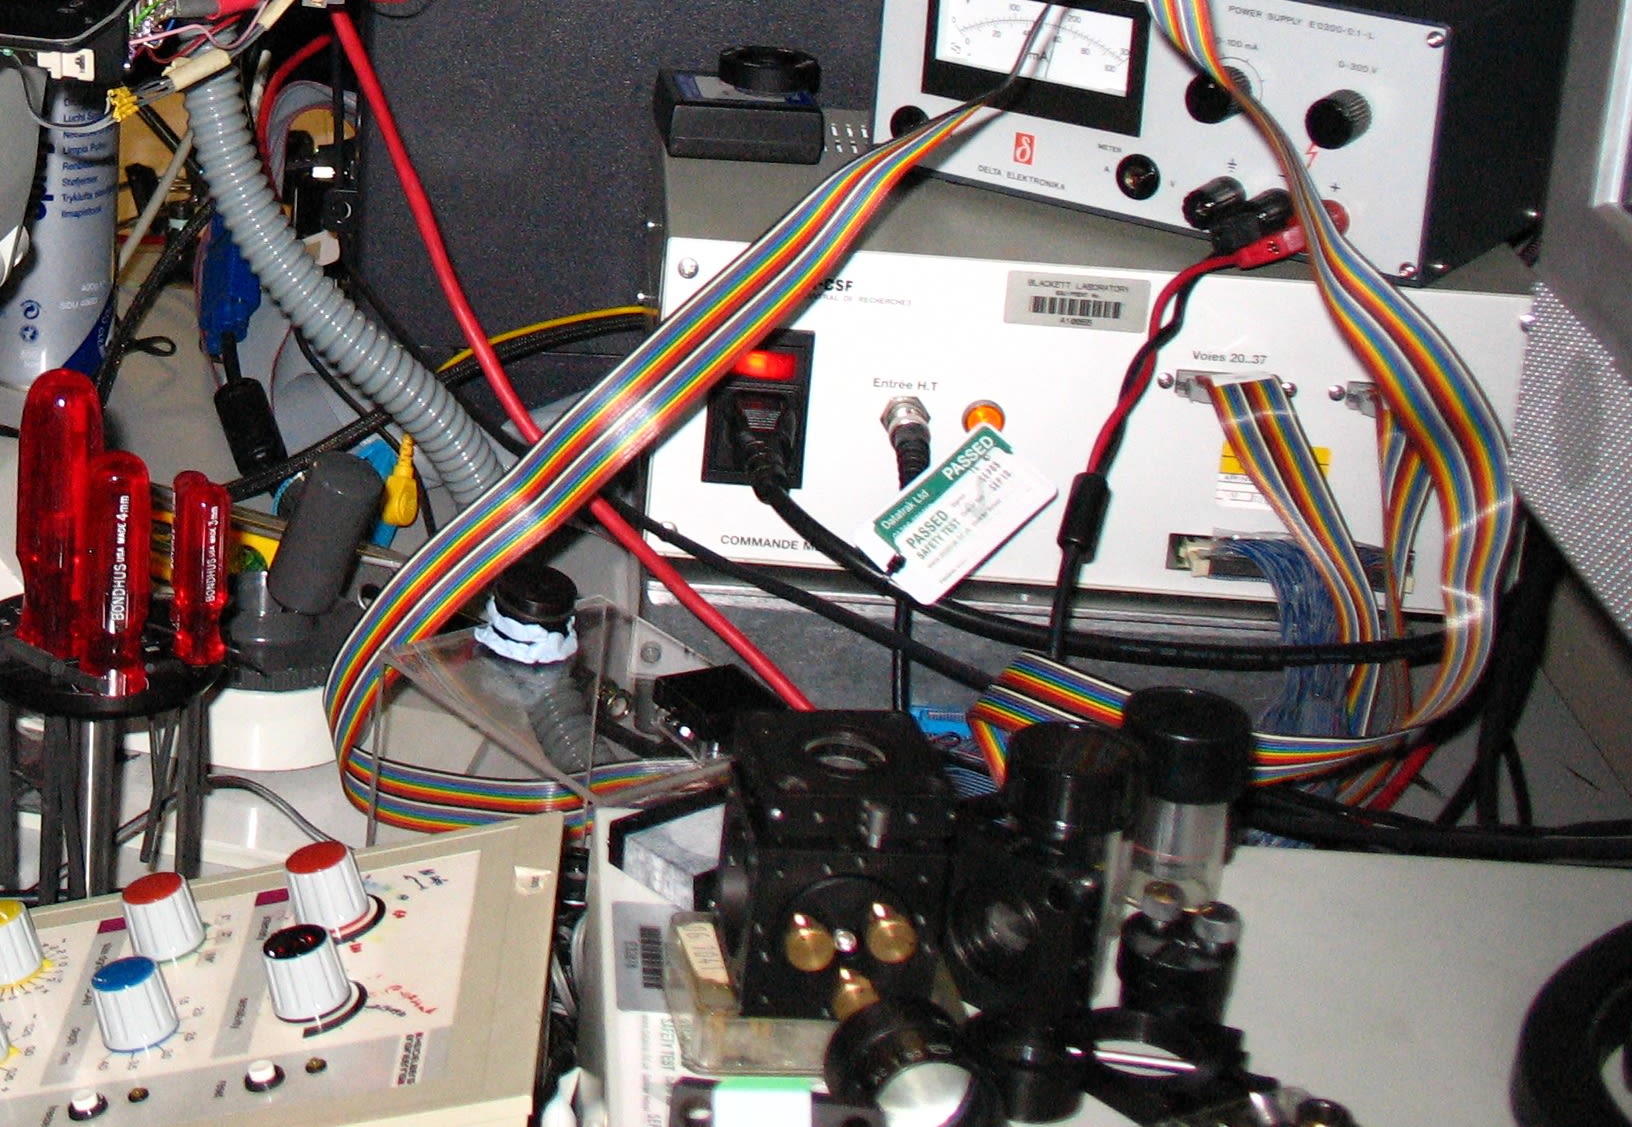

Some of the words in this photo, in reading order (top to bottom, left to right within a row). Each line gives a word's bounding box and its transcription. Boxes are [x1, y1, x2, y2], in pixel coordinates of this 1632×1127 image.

[1228, 5, 1262, 18] POWER
[1267, 12, 1302, 25] SUPPLY
[977, 164, 1002, 177] DELTA
[1006, 171, 1066, 190] ELEKTRONIKA
[1027, 278, 1071, 289] BLACKETT
[1076, 283, 1129, 293] LABORATORY
[1193, 350, 1226, 362] Voies
[942, 436, 994, 480] PASSED
[912, 489, 930, 505] Ltd
[116, 495, 129, 521] 4mm
[208, 505, 219, 526] 3mm
[117, 522, 127, 545] MADE
[208, 527, 217, 544] MADE
[906, 509, 949, 549] PASSED
[916, 533, 945, 560] SAFETY
[942, 518, 961, 537] TEST
[208, 546, 216, 559] USA
[720, 534, 799, 550] COMMANDE
[115, 546, 125, 562] USA
[205, 558, 216, 602] BONDHUS
[111, 563, 127, 620] BONDHUS
[660, 1019, 674, 1049] SAFETY
[660, 1050, 675, 1070] TEST
